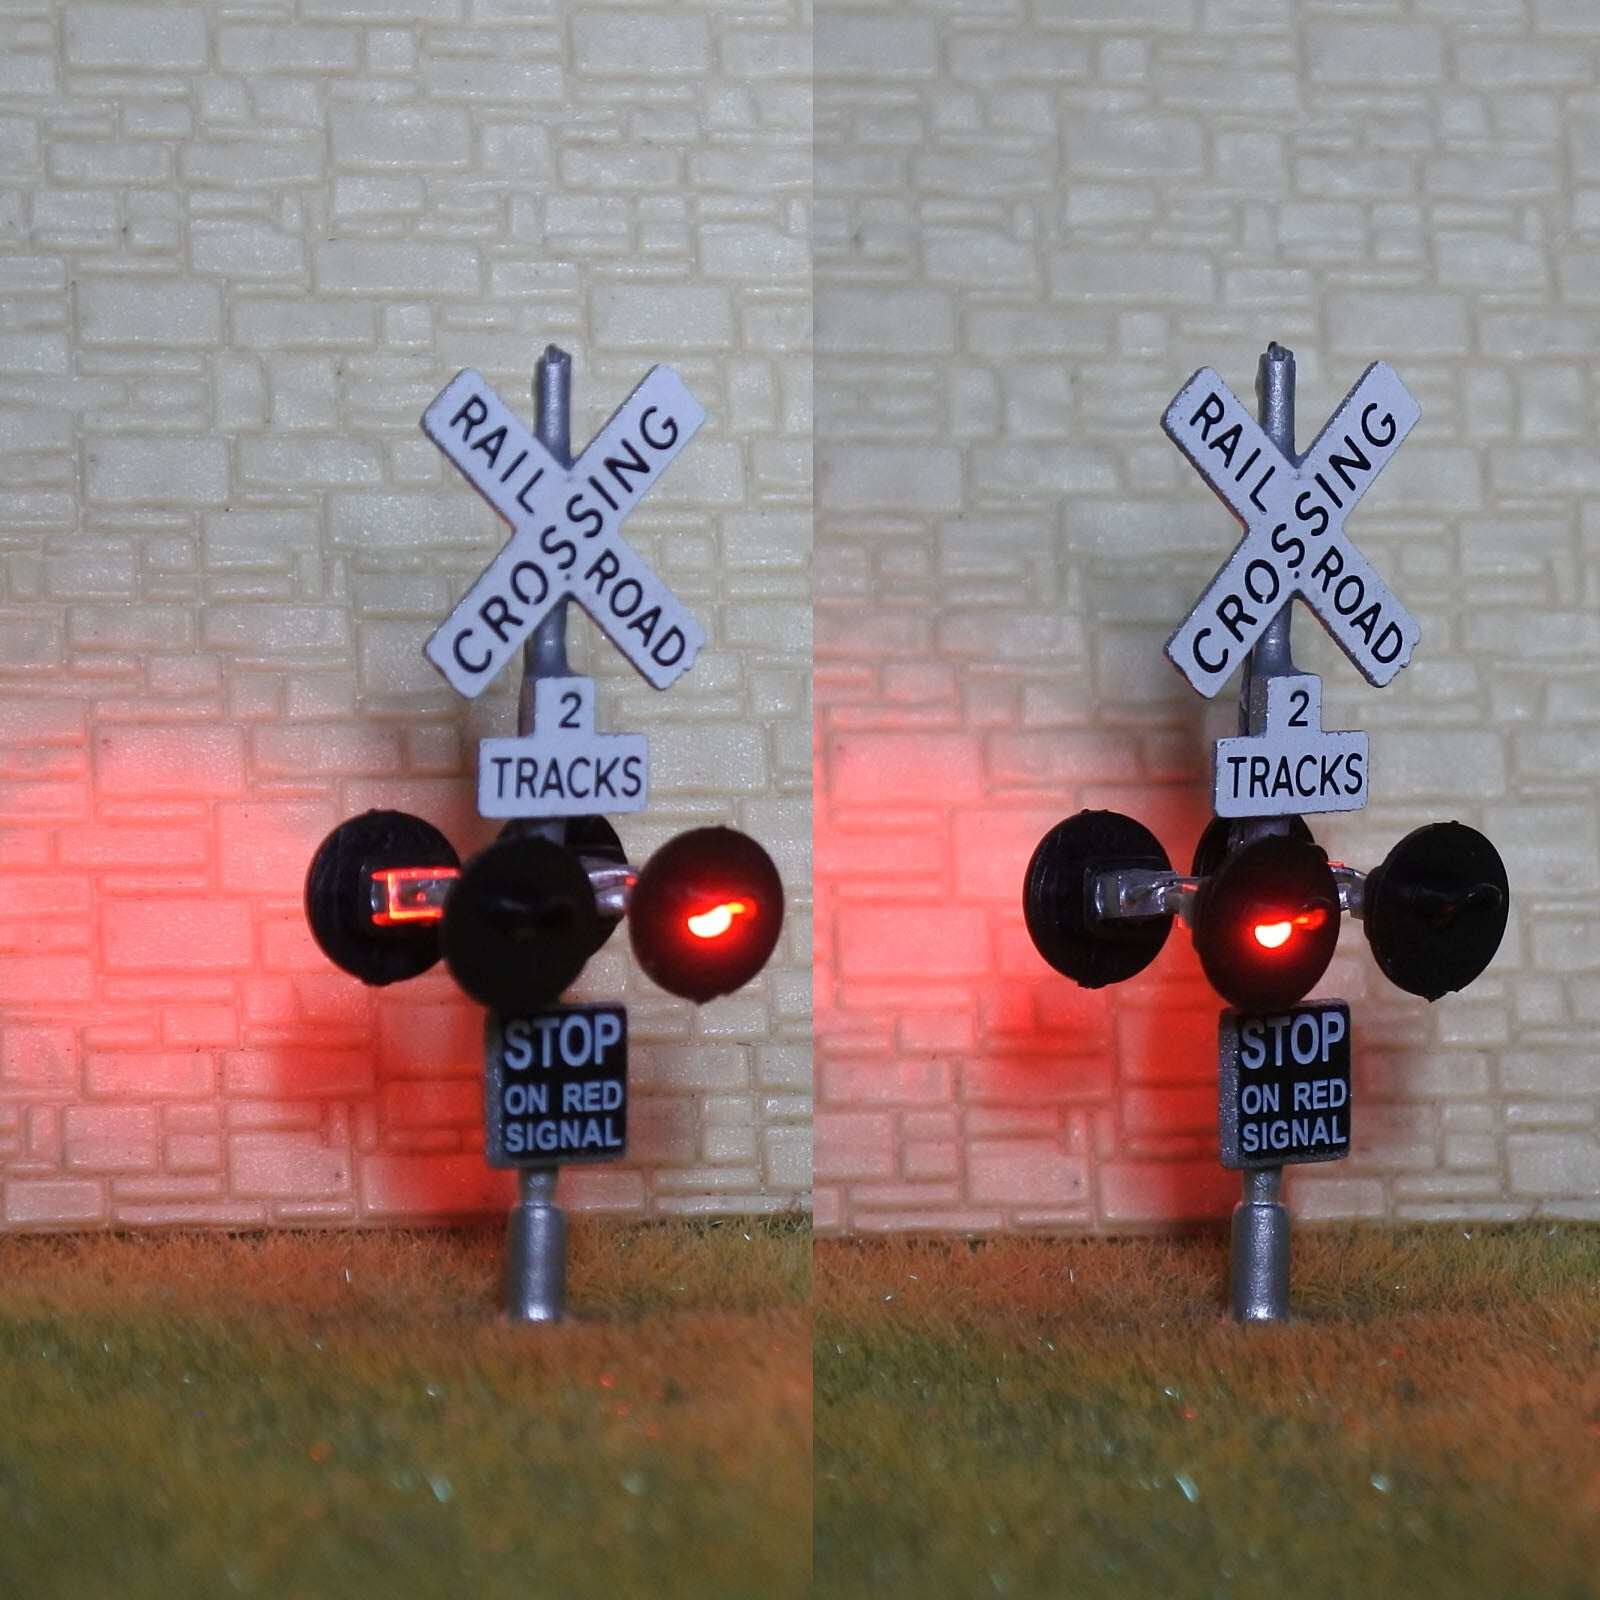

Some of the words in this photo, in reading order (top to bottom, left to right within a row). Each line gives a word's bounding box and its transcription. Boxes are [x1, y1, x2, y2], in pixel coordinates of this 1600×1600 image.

[450, 394, 544, 515] RAIL
[584, 548, 686, 667] ROAD
[453, 405, 678, 673] CROSSING
[1190, 392, 1275, 514] RAIL
[1311, 546, 1403, 663] ROAD
[1193, 403, 1396, 673] CROSSING
[558, 691, 582, 728] 2
[1288, 690, 1310, 727] 2
[490, 756, 642, 798] TRACKS
[1227, 753, 1363, 798] TRACKS
[504, 1013, 621, 1070] STOP
[1241, 1011, 1345, 1069] STOP
[504, 1083, 547, 1115] ON
[562, 1080, 623, 1113] RED
[1241, 1083, 1280, 1114] ON
[1293, 1078, 1347, 1111] RED
[504, 1117, 621, 1152] SIGNAL
[1242, 1115, 1347, 1151] SIGNAL
